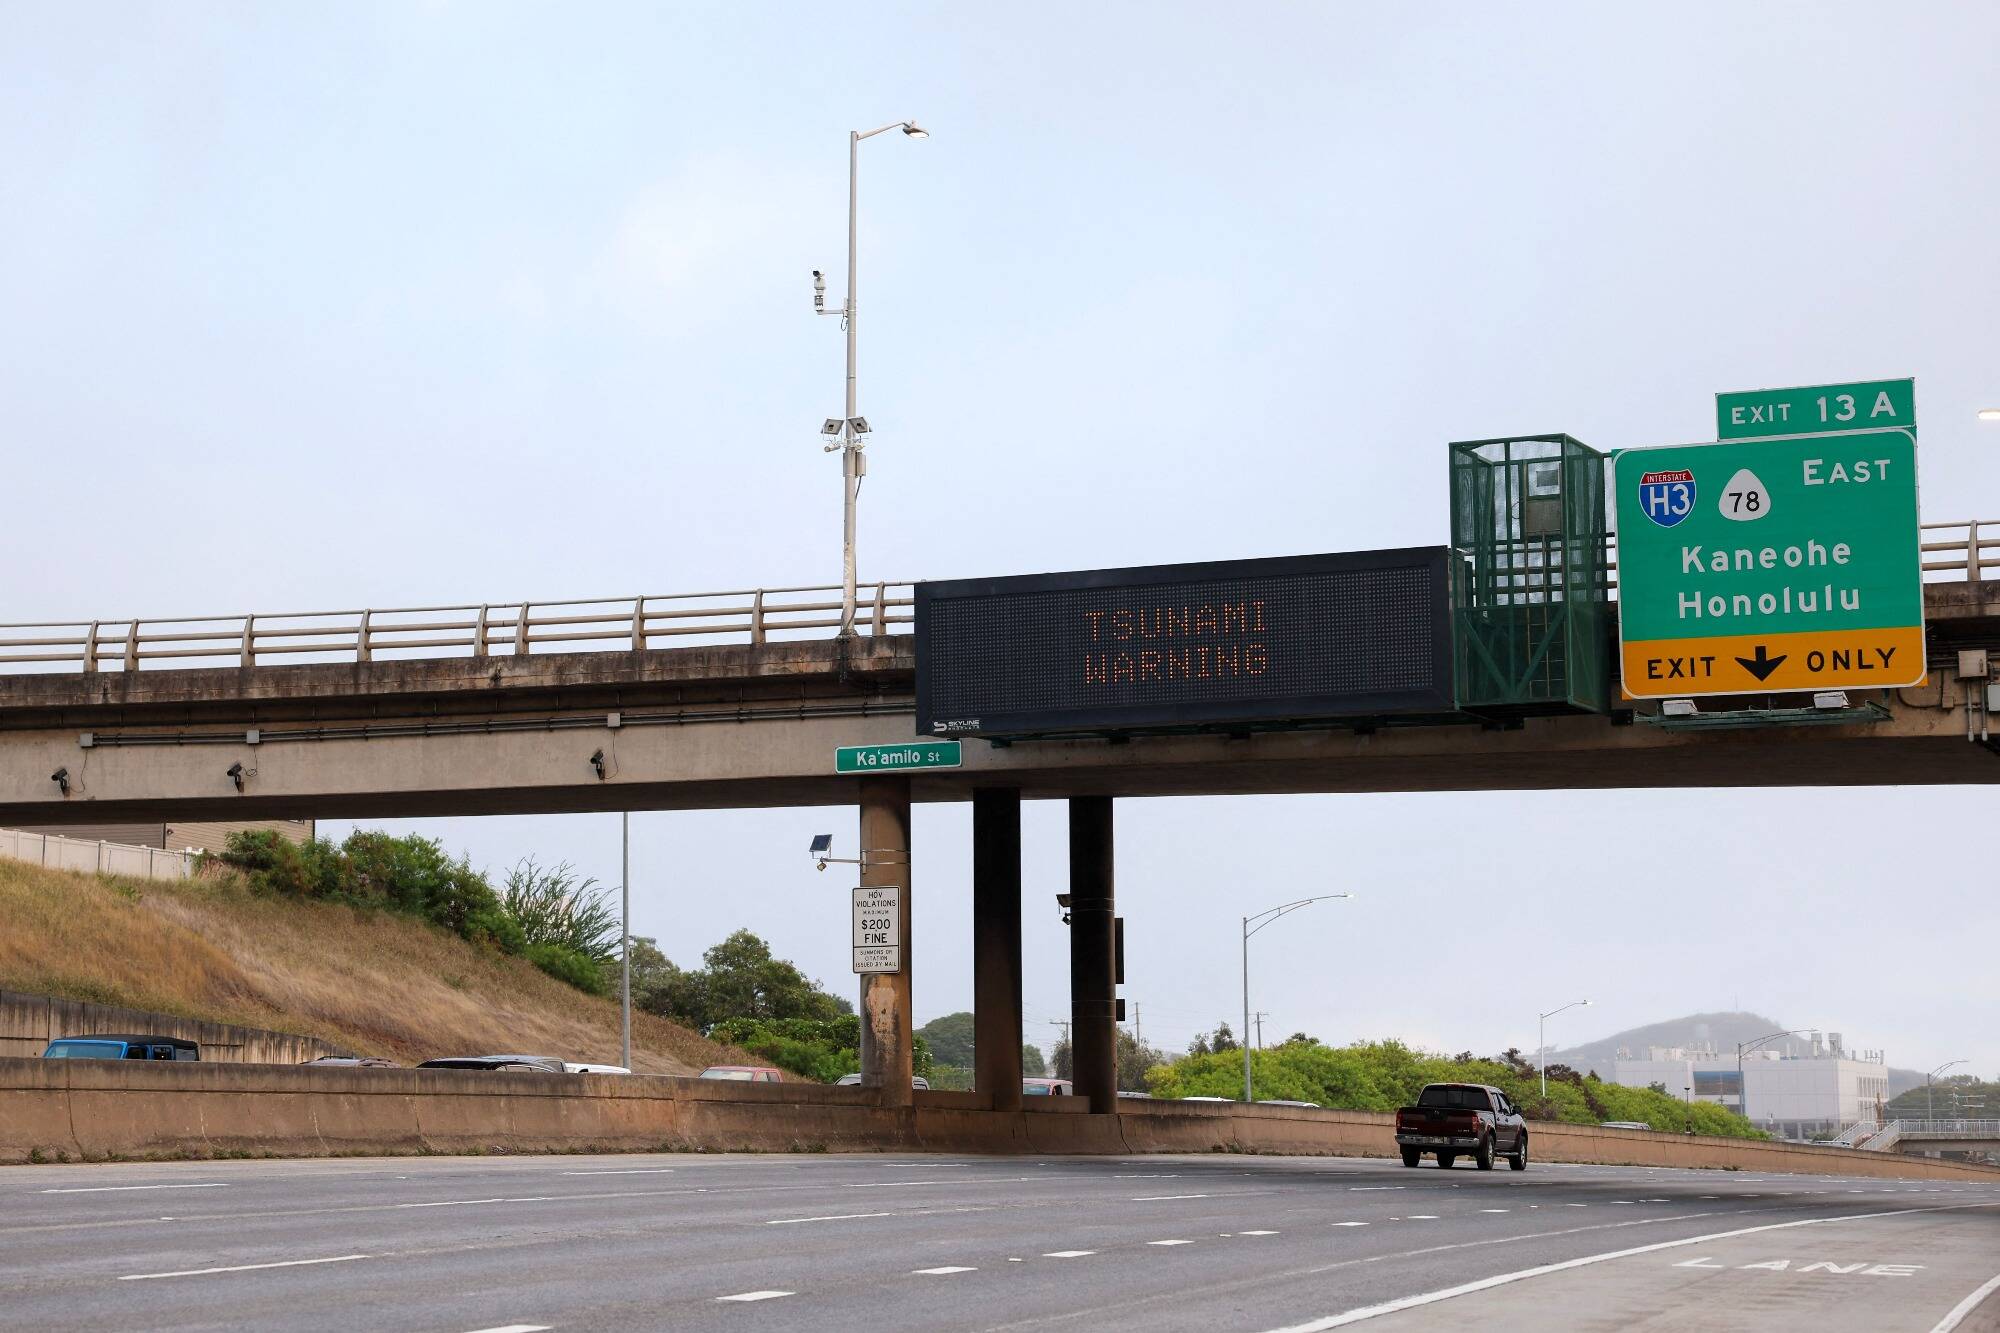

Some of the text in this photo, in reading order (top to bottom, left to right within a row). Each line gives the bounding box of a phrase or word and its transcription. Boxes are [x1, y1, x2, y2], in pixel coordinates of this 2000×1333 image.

[1731, 391, 1897, 425] EXIT 13 A
[1646, 472, 1688, 483] INTERSTATE
[1802, 458, 1891, 486] EAST
[1649, 484, 1691, 517] H3
[1728, 490, 1760, 513] 78
[1681, 539, 1852, 574] Kaneohe
[1677, 584, 1860, 619] Honolulu
[1084, 600, 1267, 642] TSUNAMI
[1084, 642, 1269, 685] WARNING
[1647, 647, 1897, 680] EXIT ONLY
[948, 719, 980, 727] SKYLINE
[927, 751, 940, 762] St
[856, 899, 897, 908] VIOLATIONS
[861, 918, 891, 930] $200
[864, 932, 888, 944] FINE
[1671, 1257, 1928, 1276] LANE
